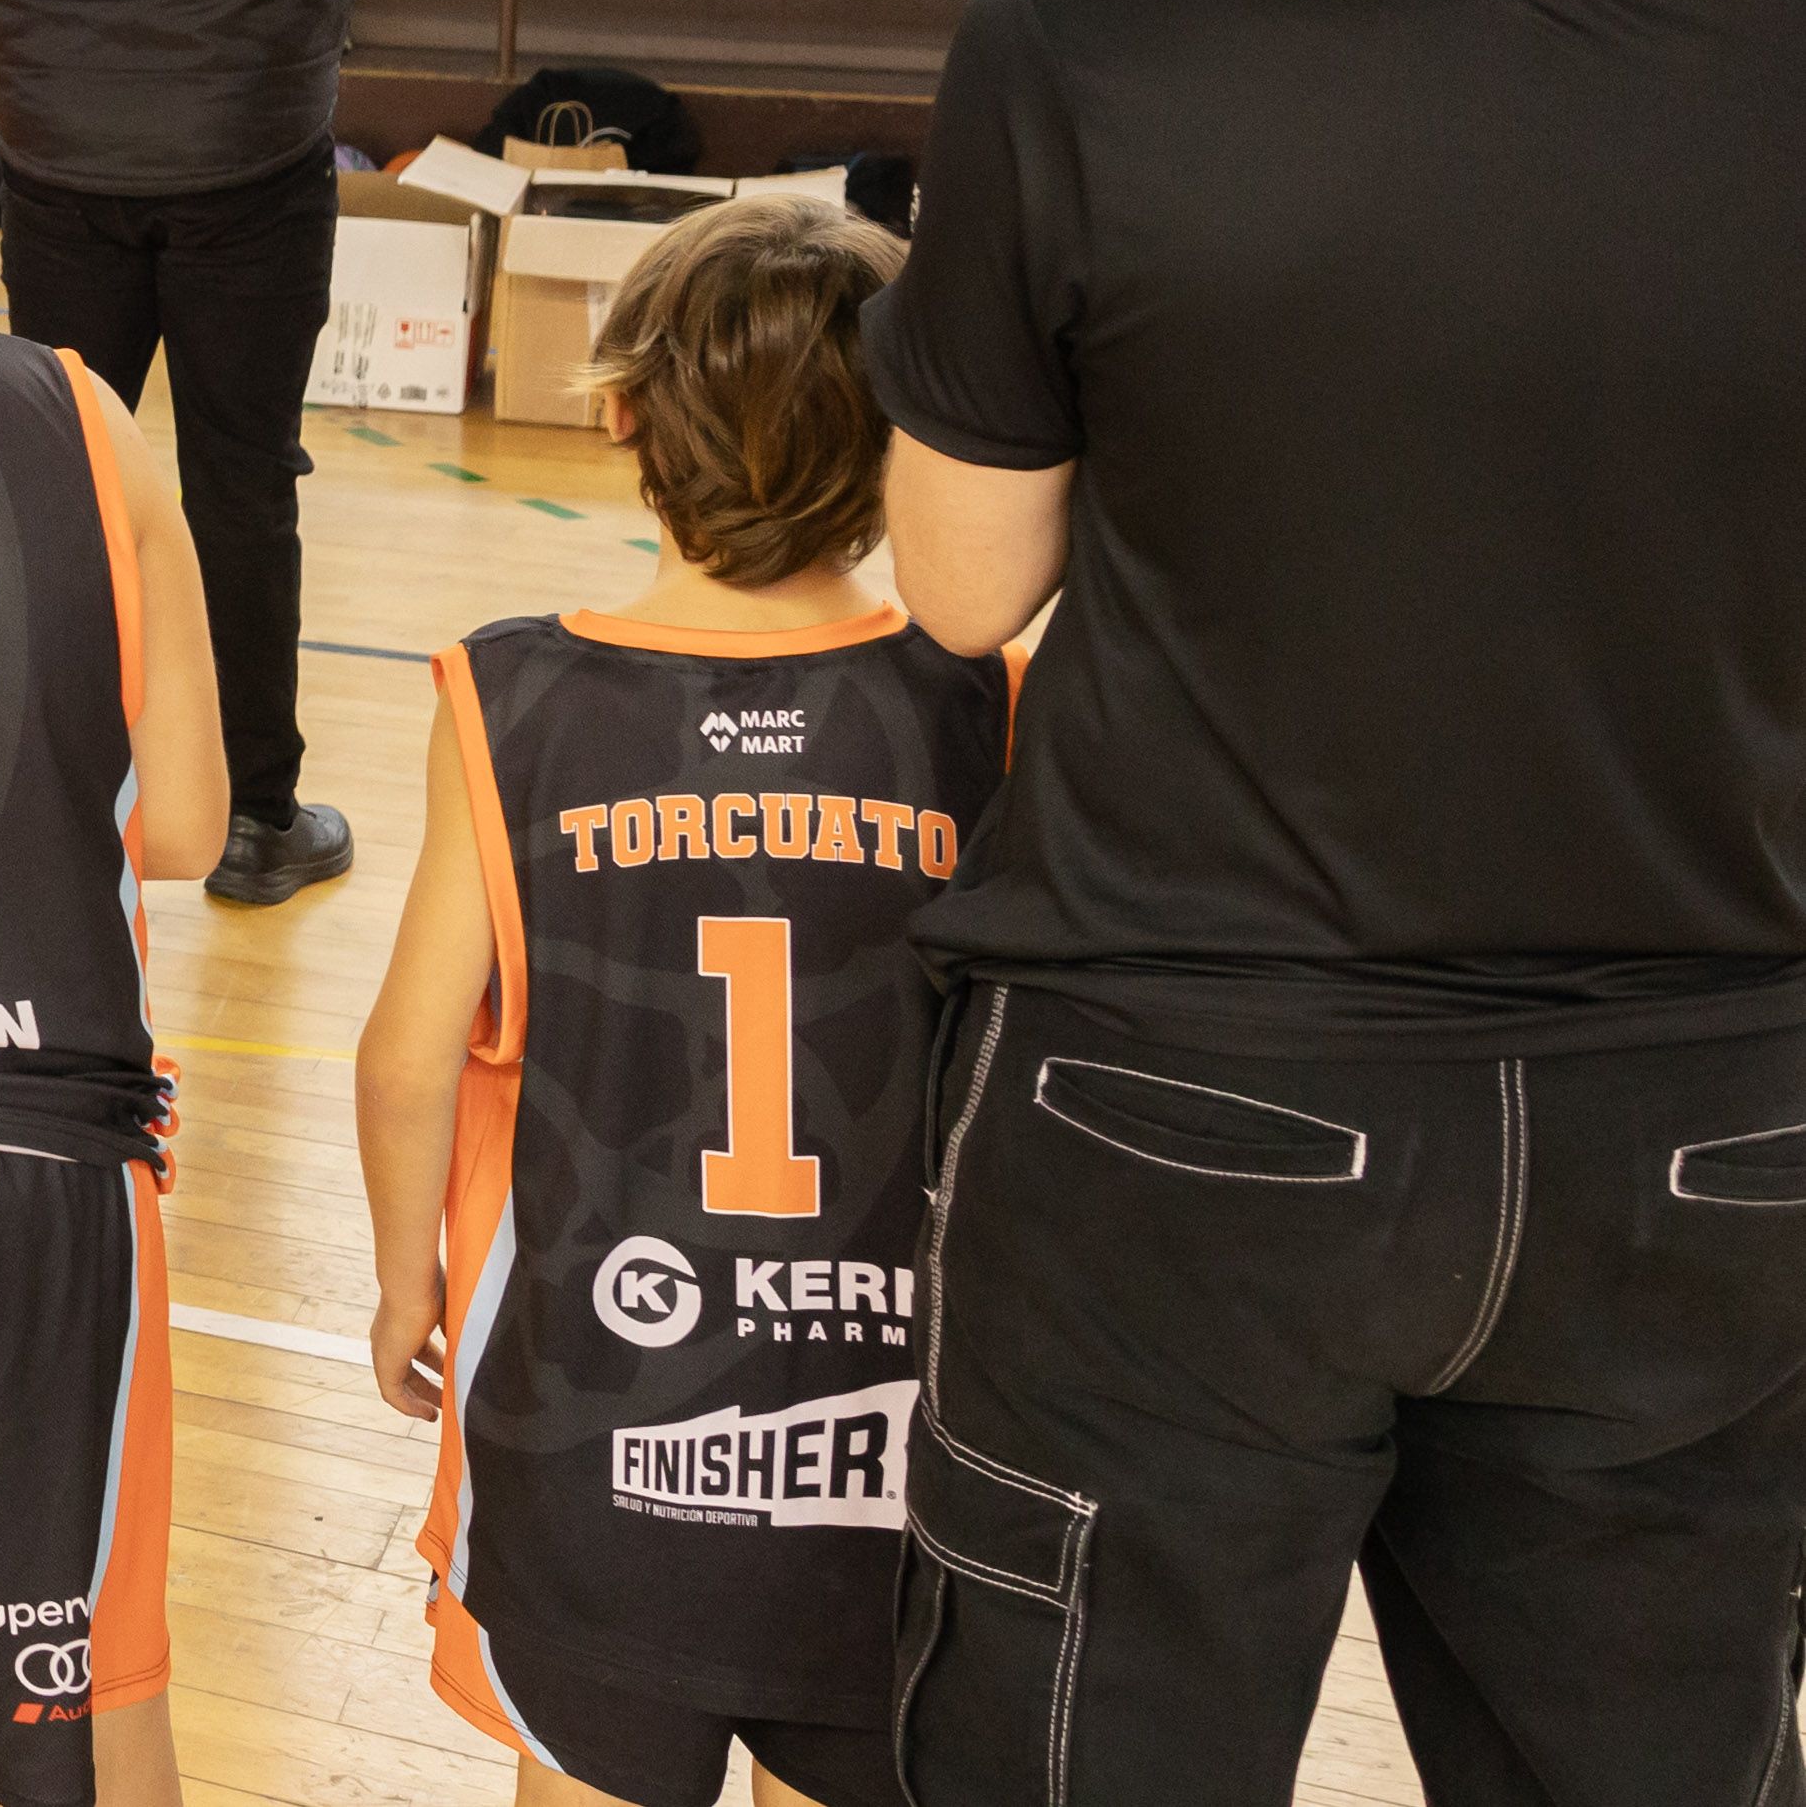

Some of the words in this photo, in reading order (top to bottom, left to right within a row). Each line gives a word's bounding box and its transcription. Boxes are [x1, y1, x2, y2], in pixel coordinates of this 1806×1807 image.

[739, 709, 806, 730] MARC
[741, 733, 806, 754] MART
[559, 792, 957, 881] TORCUATO
[696, 916, 820, 1219] 1
[736, 1317, 906, 1347] PHARM
[623, 1411, 888, 1501] FINISHER
[612, 1495, 643, 1513] SALUD
[644, 1503, 651, 1514] Y
[705, 1511, 758, 1527] DEPORTIVA
